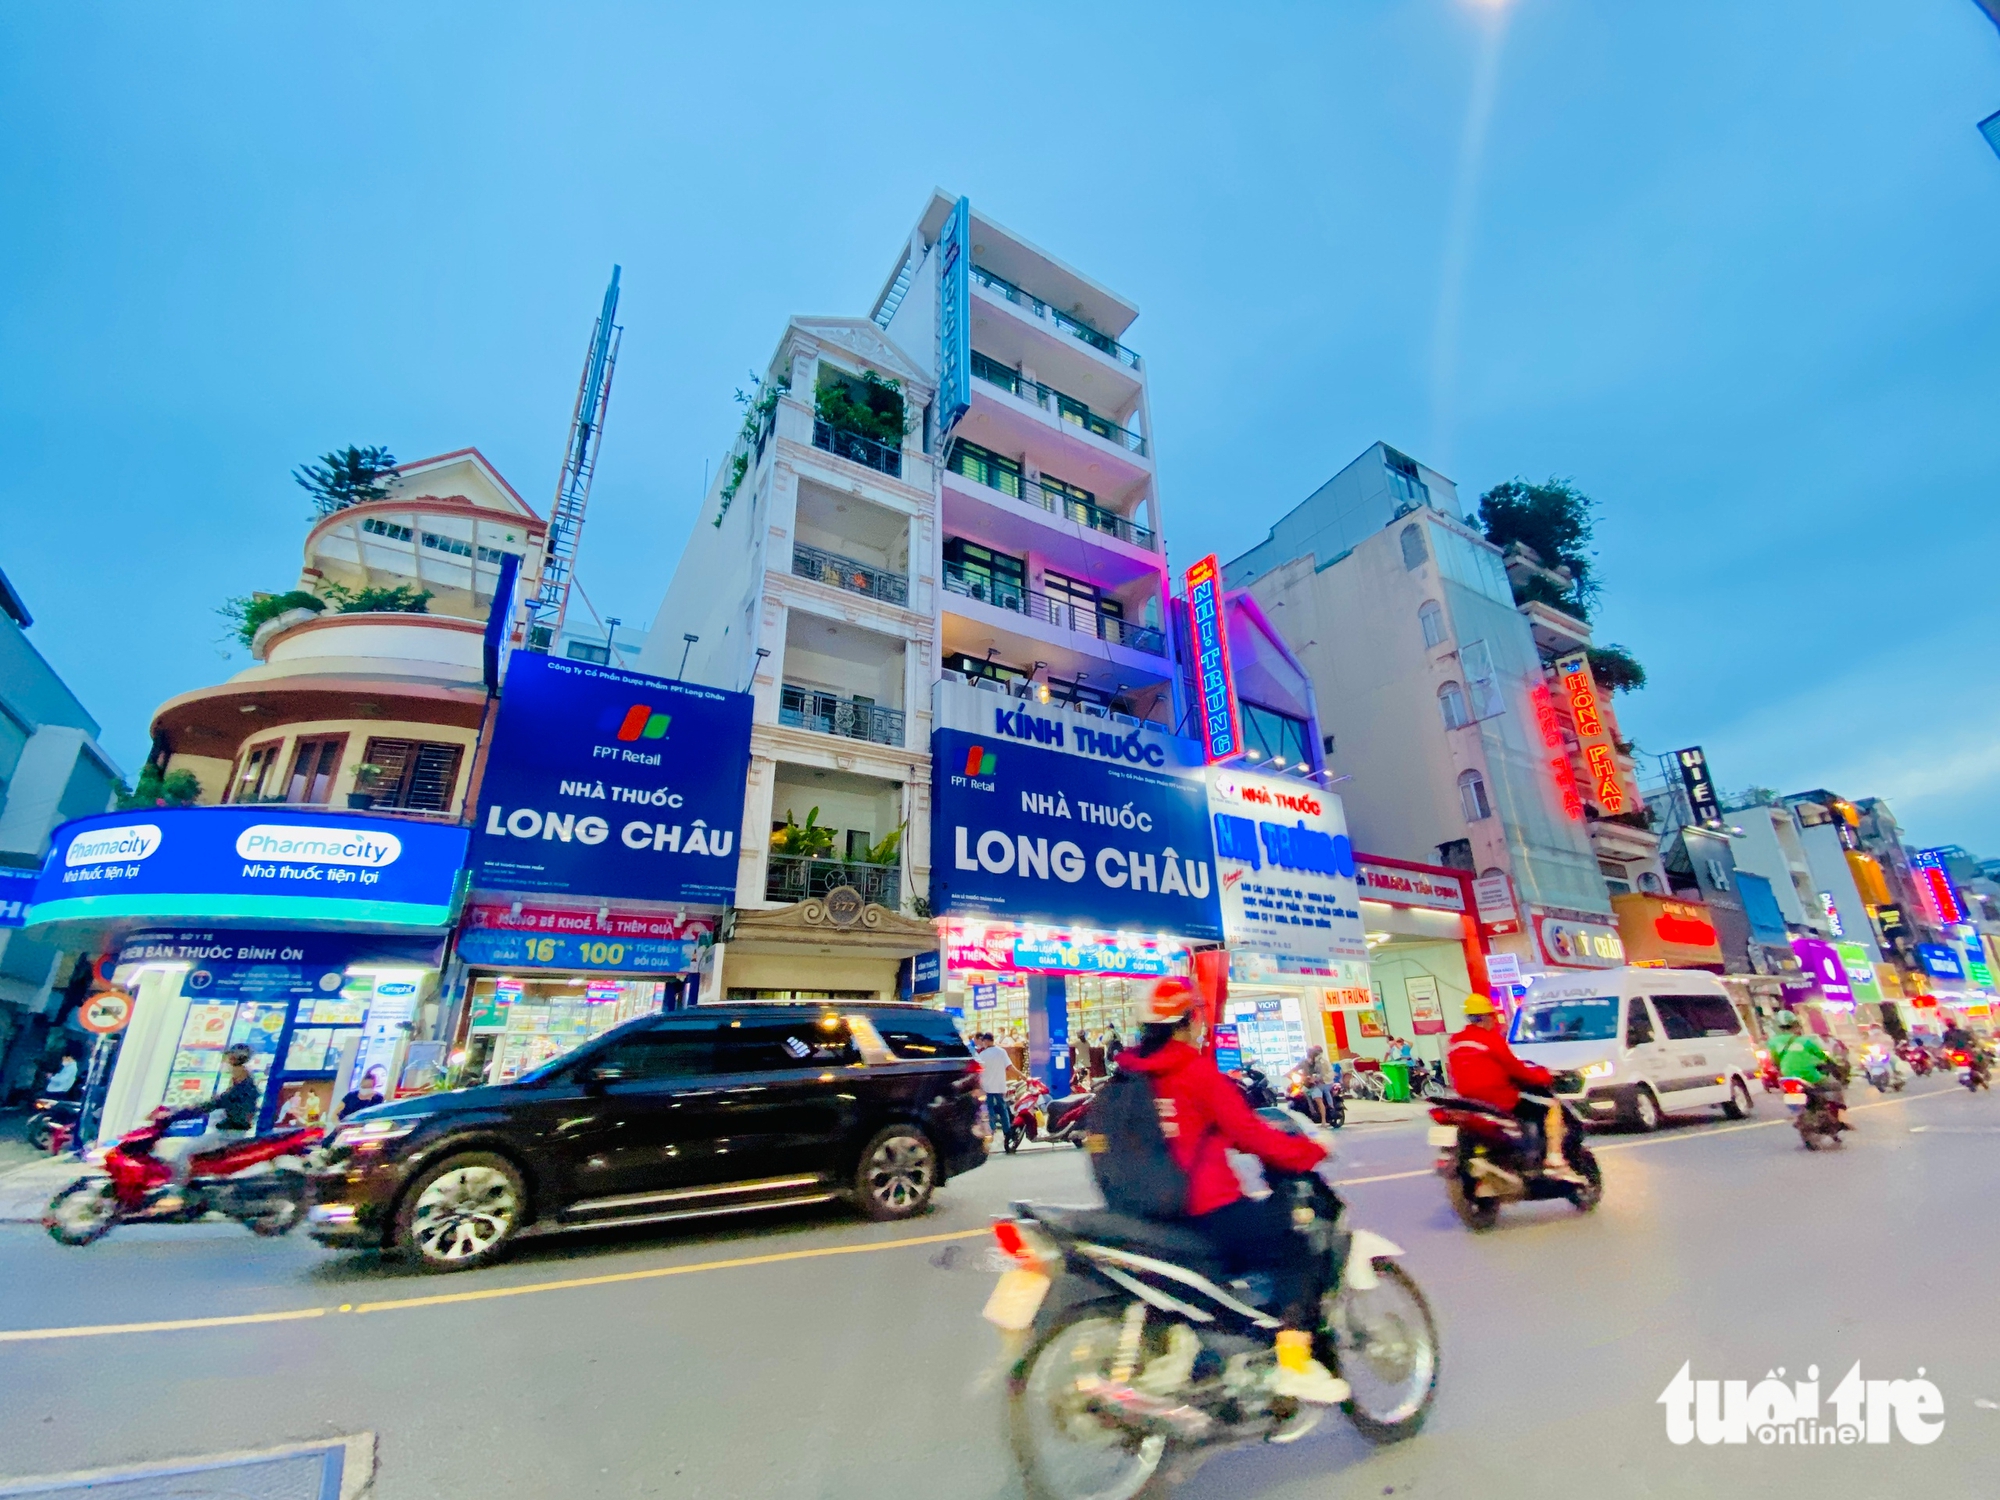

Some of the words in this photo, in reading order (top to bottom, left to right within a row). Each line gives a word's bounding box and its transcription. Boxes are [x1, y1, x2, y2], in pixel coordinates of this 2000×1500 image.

[547, 662, 572, 674] Công
[573, 667, 583, 676] Ty
[670, 685, 684, 693] FPT
[685, 687, 704, 698] Long
[705, 691, 725, 701] Châu
[995, 703, 1064, 748] KÍNH
[1072, 729, 1166, 768] THUỐC
[592, 745, 620, 760] FPT
[621, 749, 662, 767] Retail
[559, 780, 606, 801] NHÀ
[611, 786, 684, 809] THUỐC
[951, 775, 967, 789] FPT
[971, 778, 995, 793] Retail
[1021, 790, 1072, 820] NHÀ
[1077, 801, 1153, 833] THUỐC
[1241, 786, 1273, 806] NHÀ
[1274, 793, 1322, 816] THUỐC
[485, 805, 610, 845] LONG
[621, 818, 734, 858] CHÂU
[69, 831, 152, 861] Pharmacity
[246, 834, 389, 863] Pharmacity
[954, 825, 1086, 883] LONG
[1095, 846, 1211, 899] CHÂU
[62, 870, 78, 883] Nhà
[104, 866, 123, 881] tiện
[125, 864, 141, 880] lợi
[242, 864, 276, 878] Nhà
[280, 865, 323, 881] thuốc
[327, 868, 356, 884] tiện
[359, 869, 380, 886] lợi
[1367, 872, 1413, 892] FAHASA
[832, 901, 856, 912] 377
[616, 919, 647, 933] THÊM
[145, 943, 174, 958] BÁN
[178, 944, 234, 960] THUỐC
[380, 983, 413, 994] Cetaphil
[1258, 1001, 1279, 1009] VICHY
